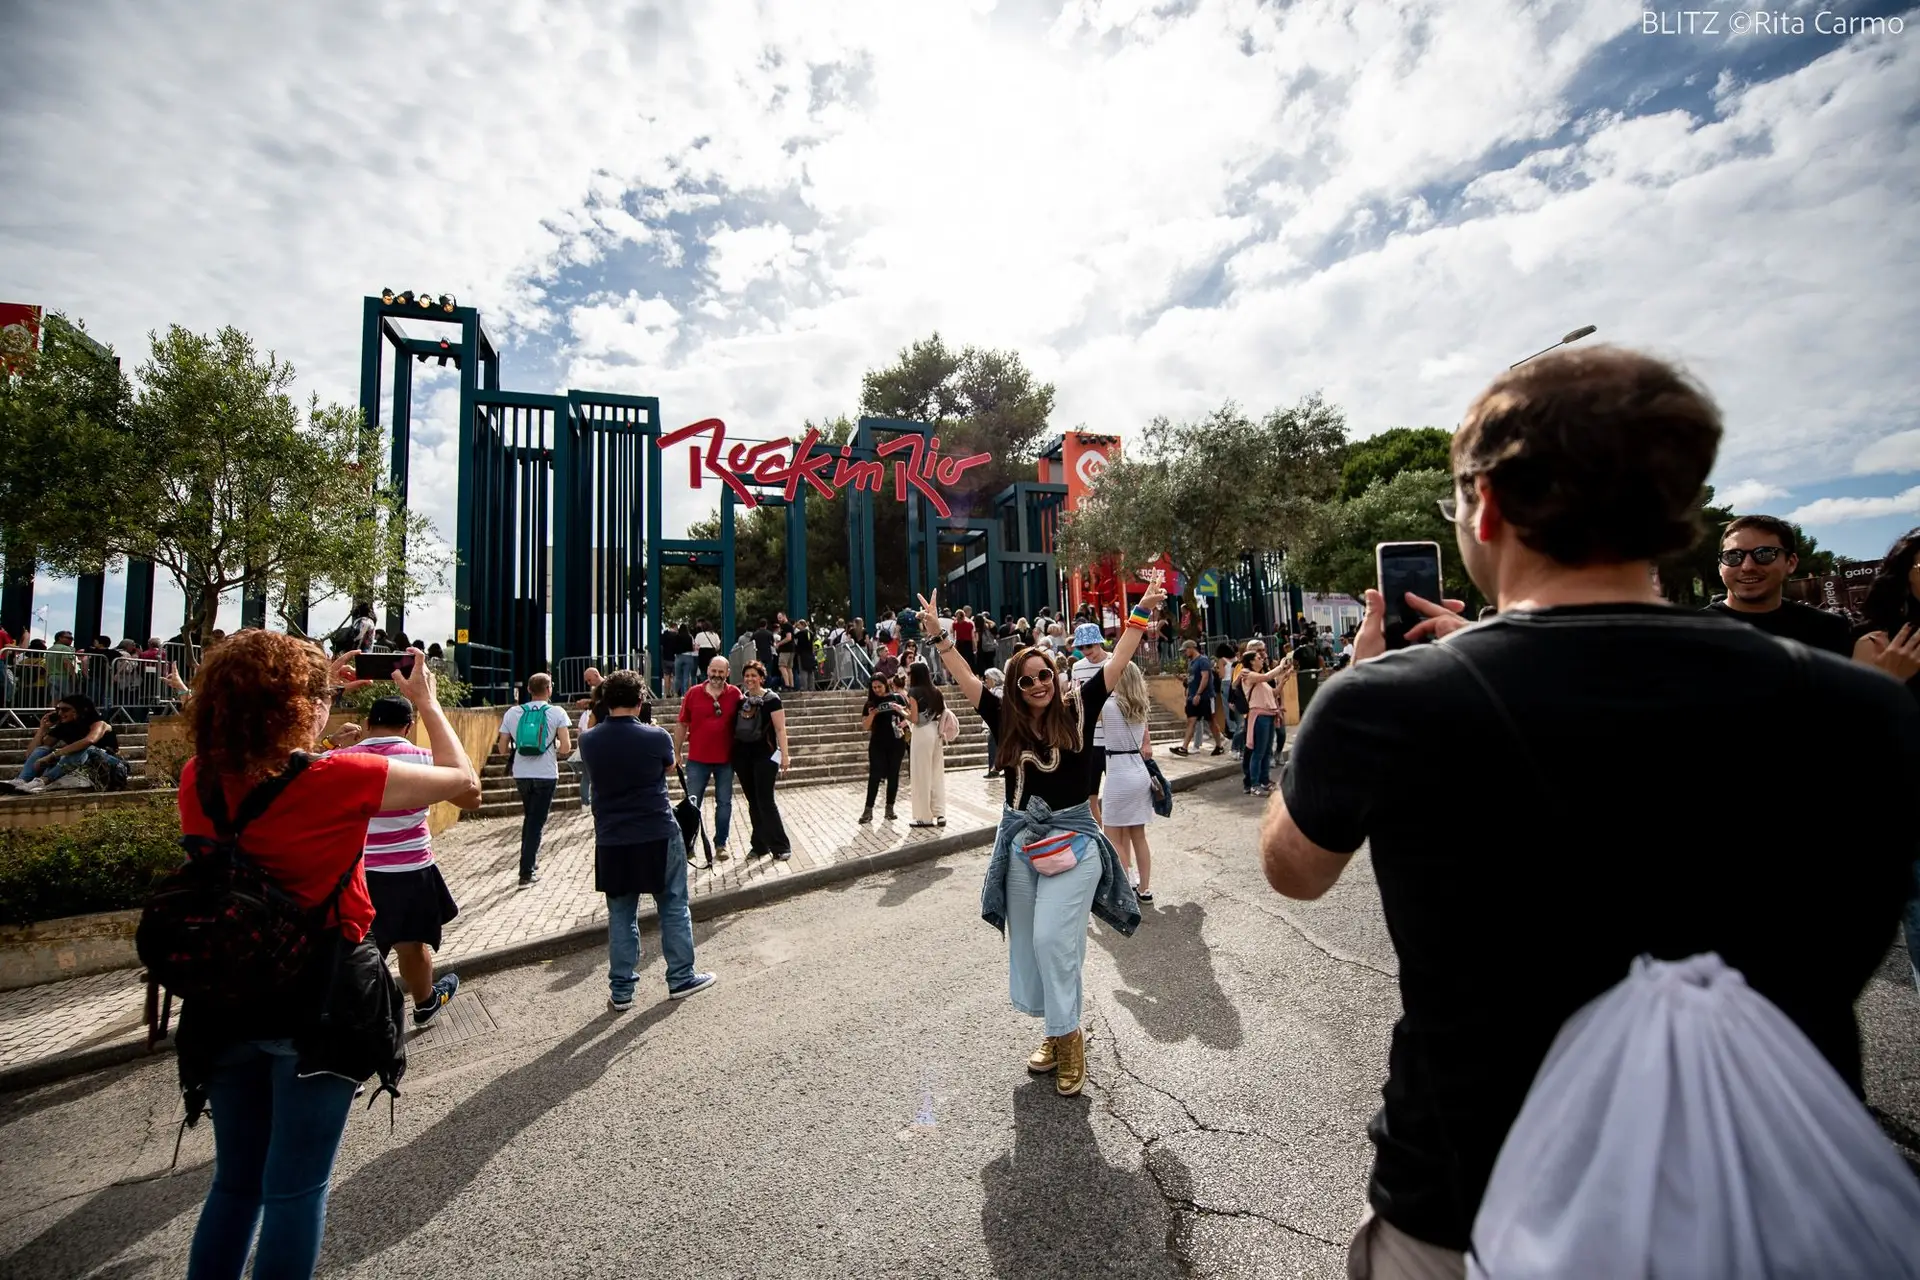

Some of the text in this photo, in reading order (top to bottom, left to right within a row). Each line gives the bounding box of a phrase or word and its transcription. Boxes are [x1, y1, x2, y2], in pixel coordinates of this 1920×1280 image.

[655, 418, 992, 519] Rock in Rio
[1844, 567, 1874, 579] gato
[1823, 581, 1839, 605] preto
